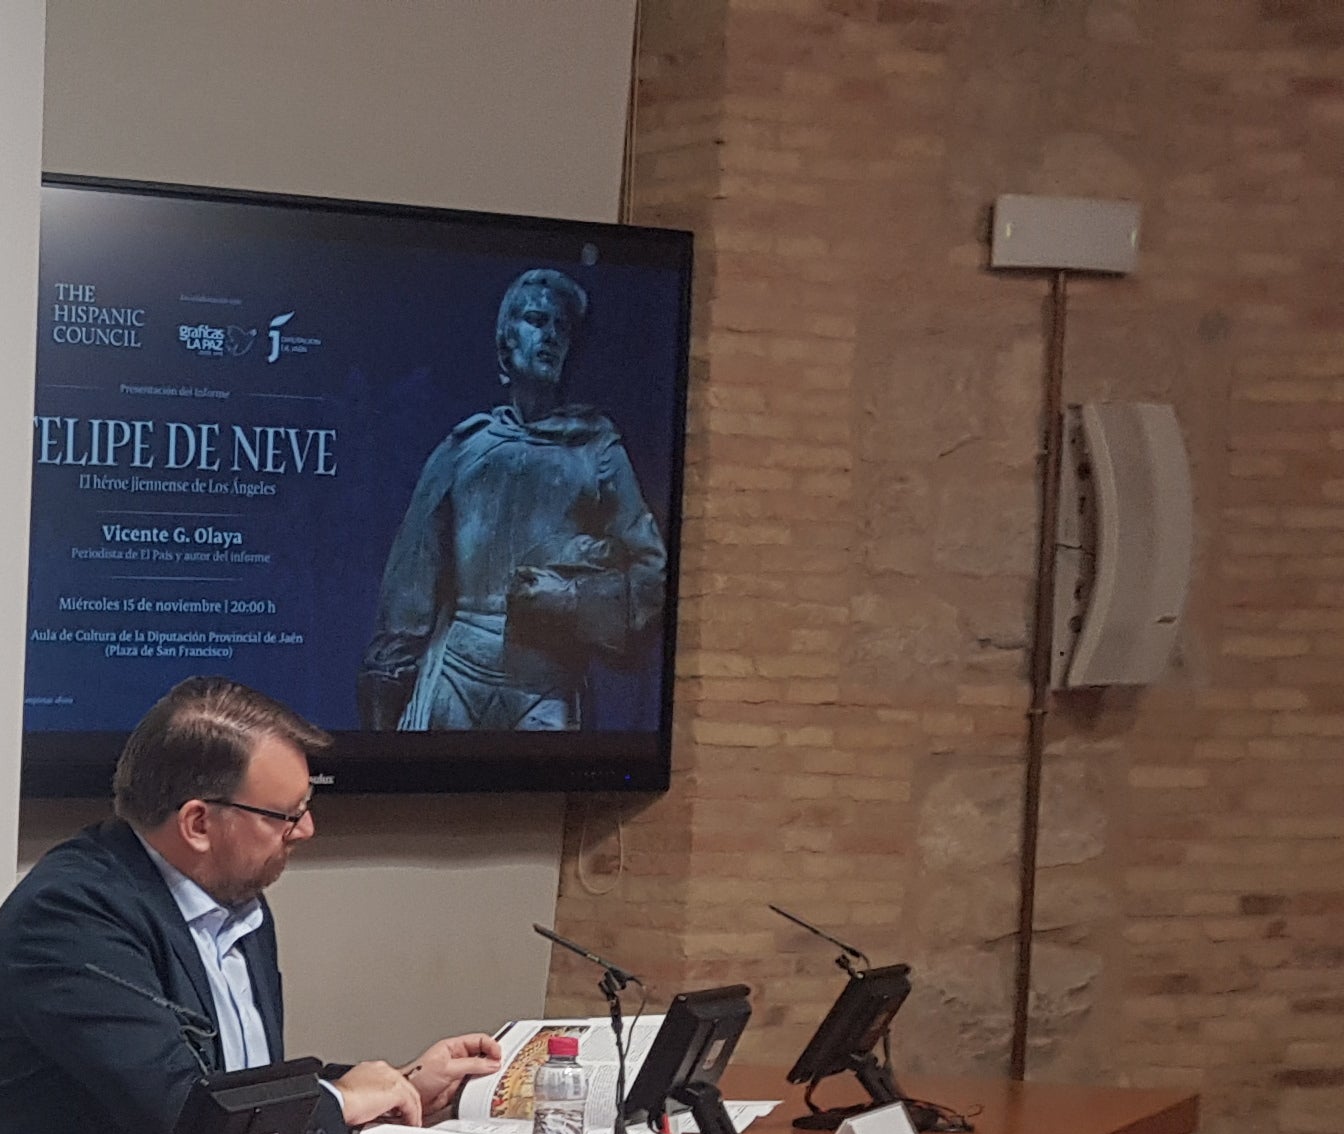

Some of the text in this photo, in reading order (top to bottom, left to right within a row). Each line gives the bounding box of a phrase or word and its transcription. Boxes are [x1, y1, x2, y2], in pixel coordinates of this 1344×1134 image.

[55, 283, 96, 302] THE
[54, 306, 144, 327] HISPANIC
[53, 326, 141, 347] COUNCIL
[33, 416, 337, 476] ELIPE DE NEVE
[191, 479, 206, 493] de
[208, 479, 229, 495] Los
[103, 525, 242, 548] Vicente G. Olaya
[71, 548, 124, 560] Periodista
[125, 549, 138, 561] de
[184, 552, 211, 563] autor
[213, 551, 229, 563] del
[59, 598, 120, 613] Miércoles
[122, 599, 135, 613] 15
[137, 599, 152, 614] de
[155, 600, 222, 615] noviembre
[230, 601, 264, 615] 20:00
[31, 630, 57, 641] Aula
[59, 630, 73, 641] de
[75, 630, 117, 642] Cultura
[119, 631, 133, 642] de
[147, 631, 206, 645] Diputación
[208, 632, 261, 644] Provincial
[263, 632, 276, 644] de
[279, 632, 304, 645] Jaén
[105, 645, 233, 659] (Plaza de San Francisco)
